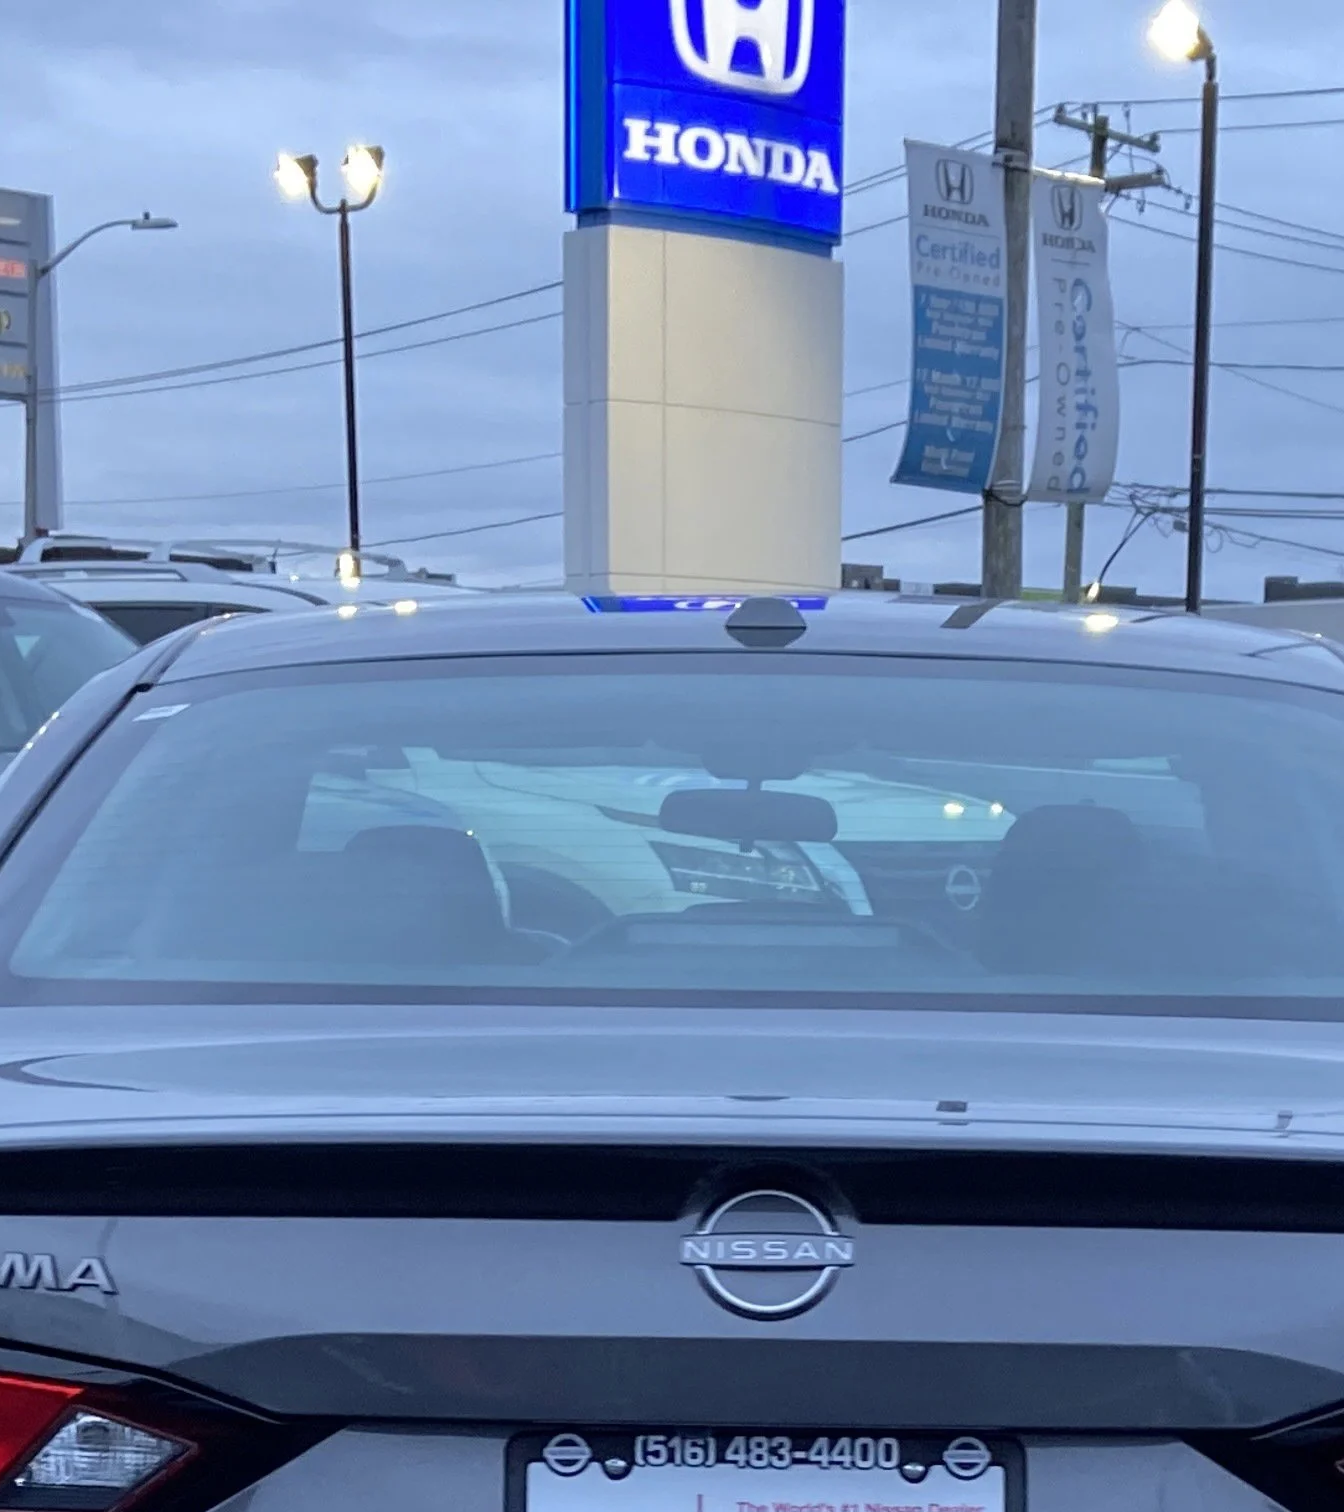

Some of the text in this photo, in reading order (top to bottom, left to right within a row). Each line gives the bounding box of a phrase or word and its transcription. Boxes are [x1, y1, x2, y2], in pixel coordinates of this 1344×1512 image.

[622, 117, 840, 195] HONDA
[922, 203, 990, 228] HONDA
[915, 234, 1001, 270] Certified
[1041, 232, 1096, 254] HONDA
[1066, 277, 1099, 494] Certified
[682, 1240, 854, 1261] NISSAN
[633, 1434, 900, 1470] (516) 483-4400
